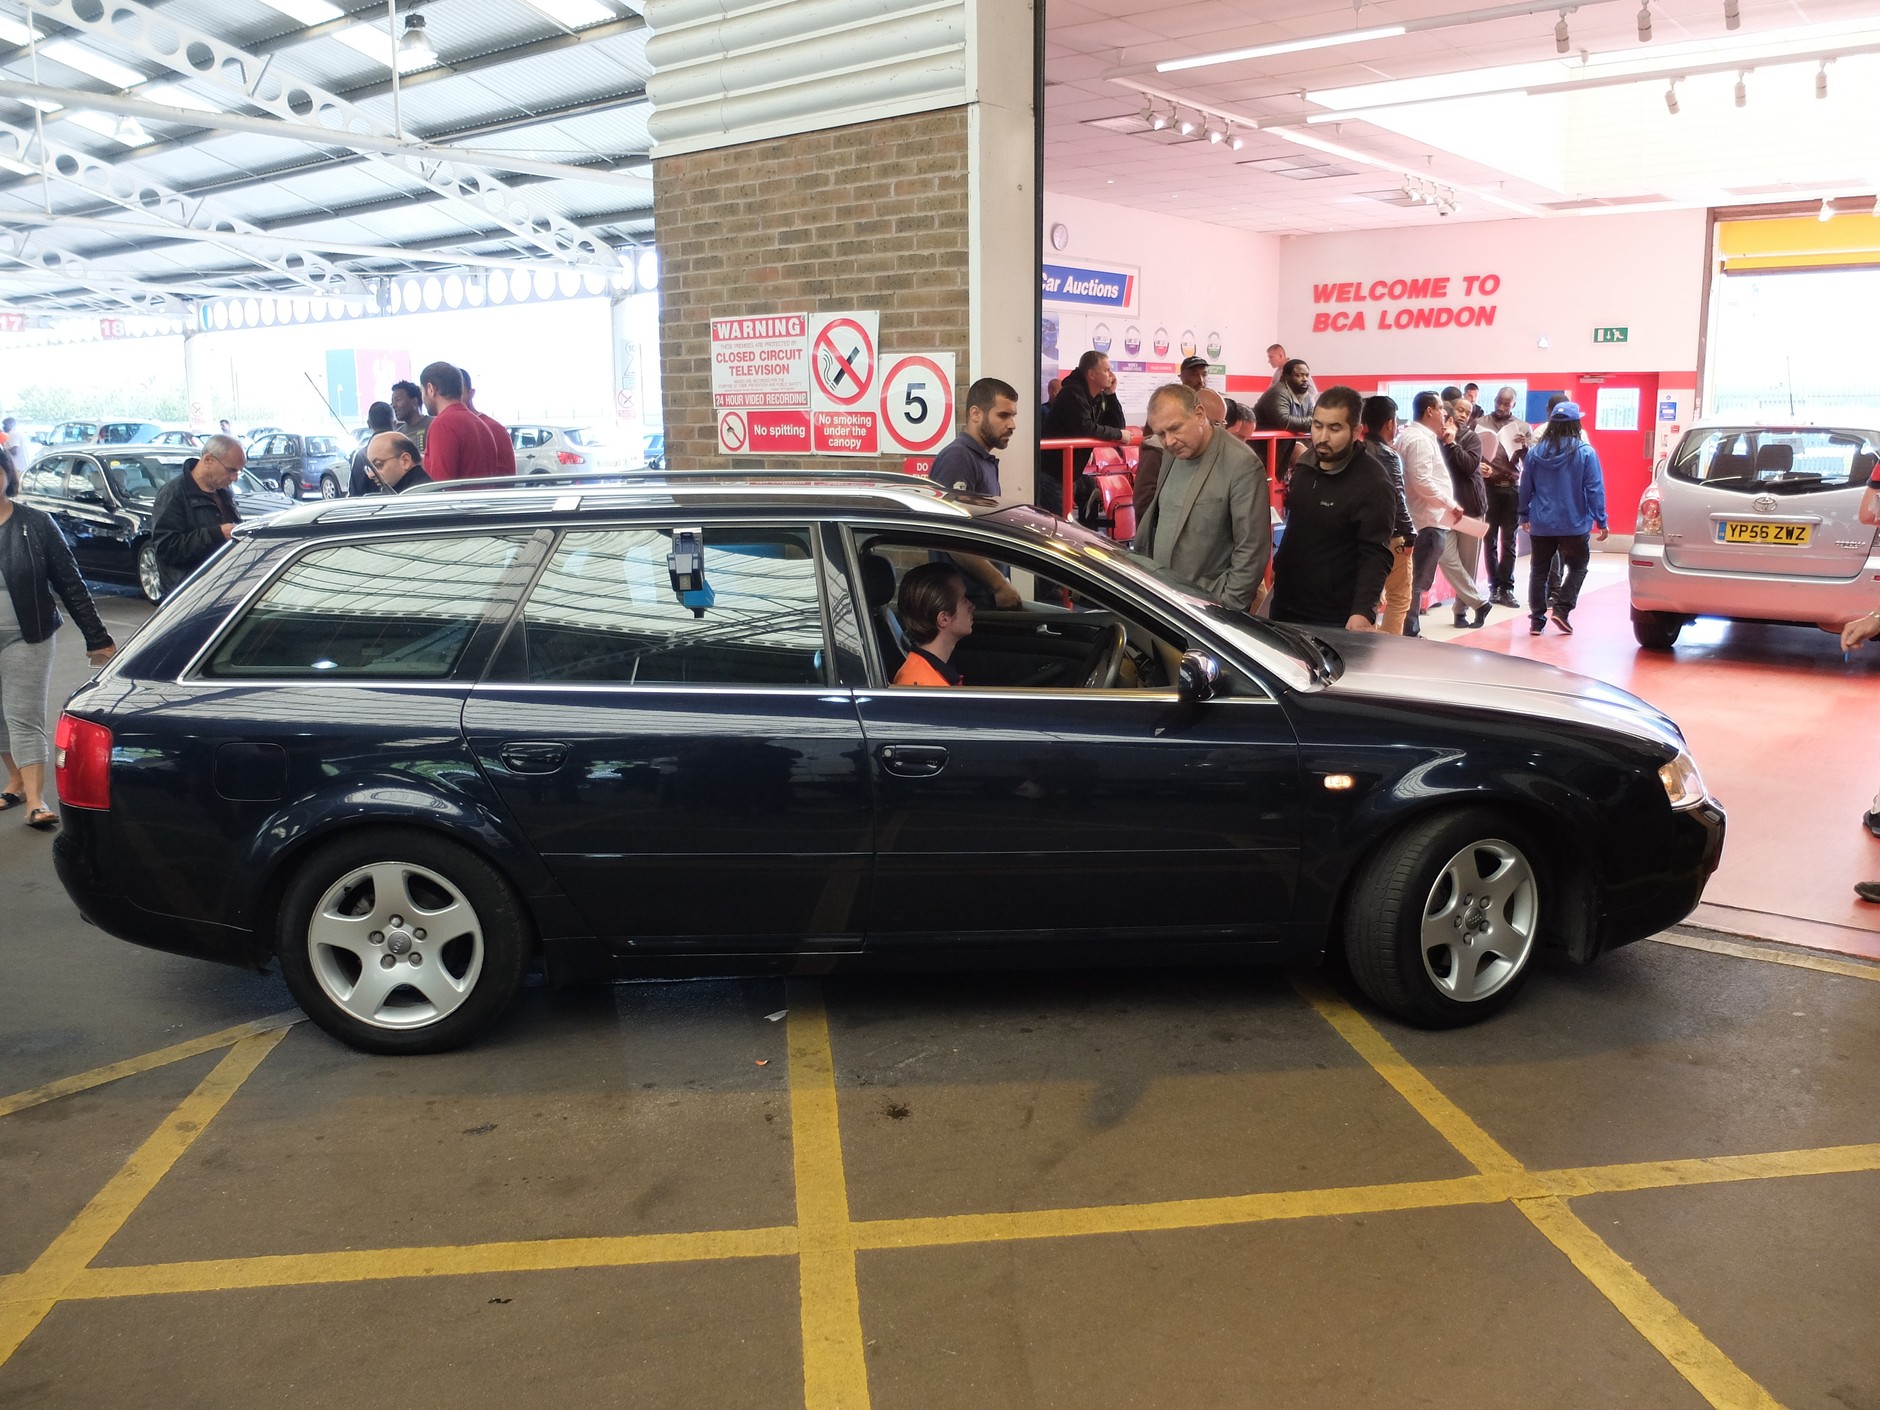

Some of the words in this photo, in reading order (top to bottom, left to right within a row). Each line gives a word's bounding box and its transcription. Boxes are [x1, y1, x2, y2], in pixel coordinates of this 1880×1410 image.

[1063, 275, 1119, 299] Auctions
[1313, 277, 1450, 303] WELCOME
[1463, 274, 1500, 297] TO
[1312, 311, 1365, 332] BCA
[1378, 305, 1497, 330] LONDON
[101, 321, 124, 337] 18
[716, 318, 801, 340] WARNING
[716, 351, 756, 363] CLOSED
[759, 348, 803, 362] CIRCUIT
[729, 364, 790, 377] TELEVISION
[715, 395, 724, 406] 24
[725, 394, 743, 405] HOUR
[744, 394, 764, 405] VIDEO
[766, 393, 807, 405] RECORDING
[904, 382, 928, 424] 5
[818, 414, 831, 425] No
[833, 414, 872, 428] smoking
[754, 424, 767, 436] No
[769, 423, 806, 437] spitting
[823, 425, 849, 436] under
[851, 425, 866, 436] the
[828, 437, 862, 450] canopy
[916, 462, 929, 471] DO
[1730, 524, 1770, 539] YP56
[1774, 526, 1806, 541] ZWZ
